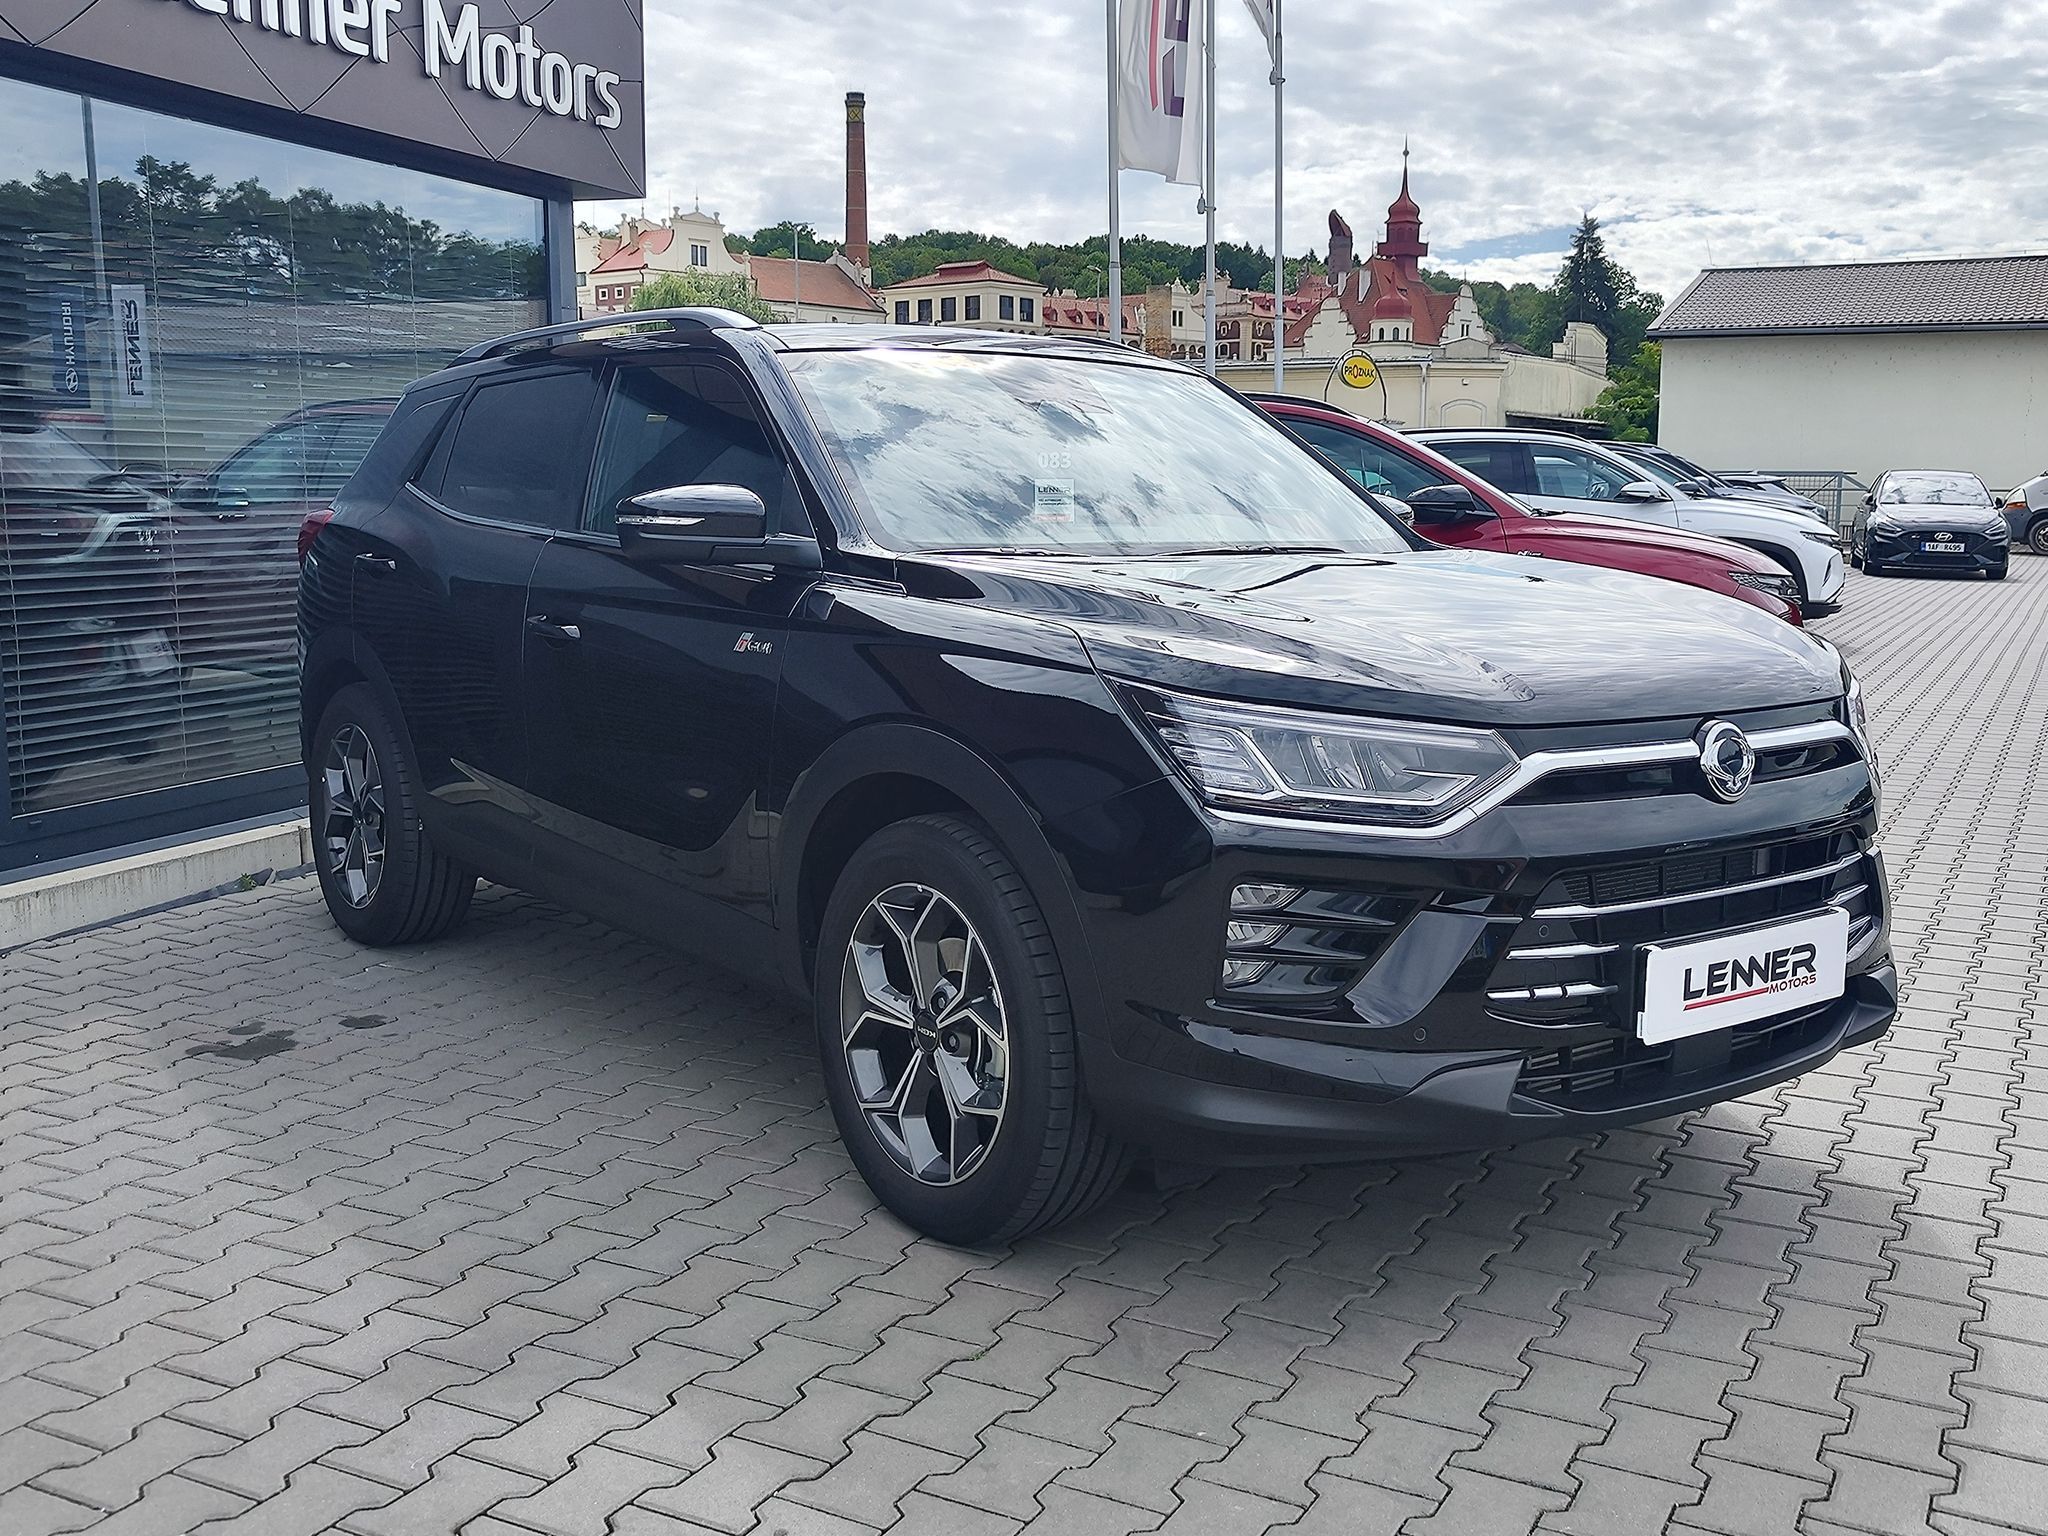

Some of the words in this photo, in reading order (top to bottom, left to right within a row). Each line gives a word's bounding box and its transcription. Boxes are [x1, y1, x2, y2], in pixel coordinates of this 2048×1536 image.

[421, 0, 623, 130] Motors
[1038, 452, 1072, 469] 083
[1683, 943, 1817, 1001] LENNER
[1769, 973, 1817, 994] MOTORS
